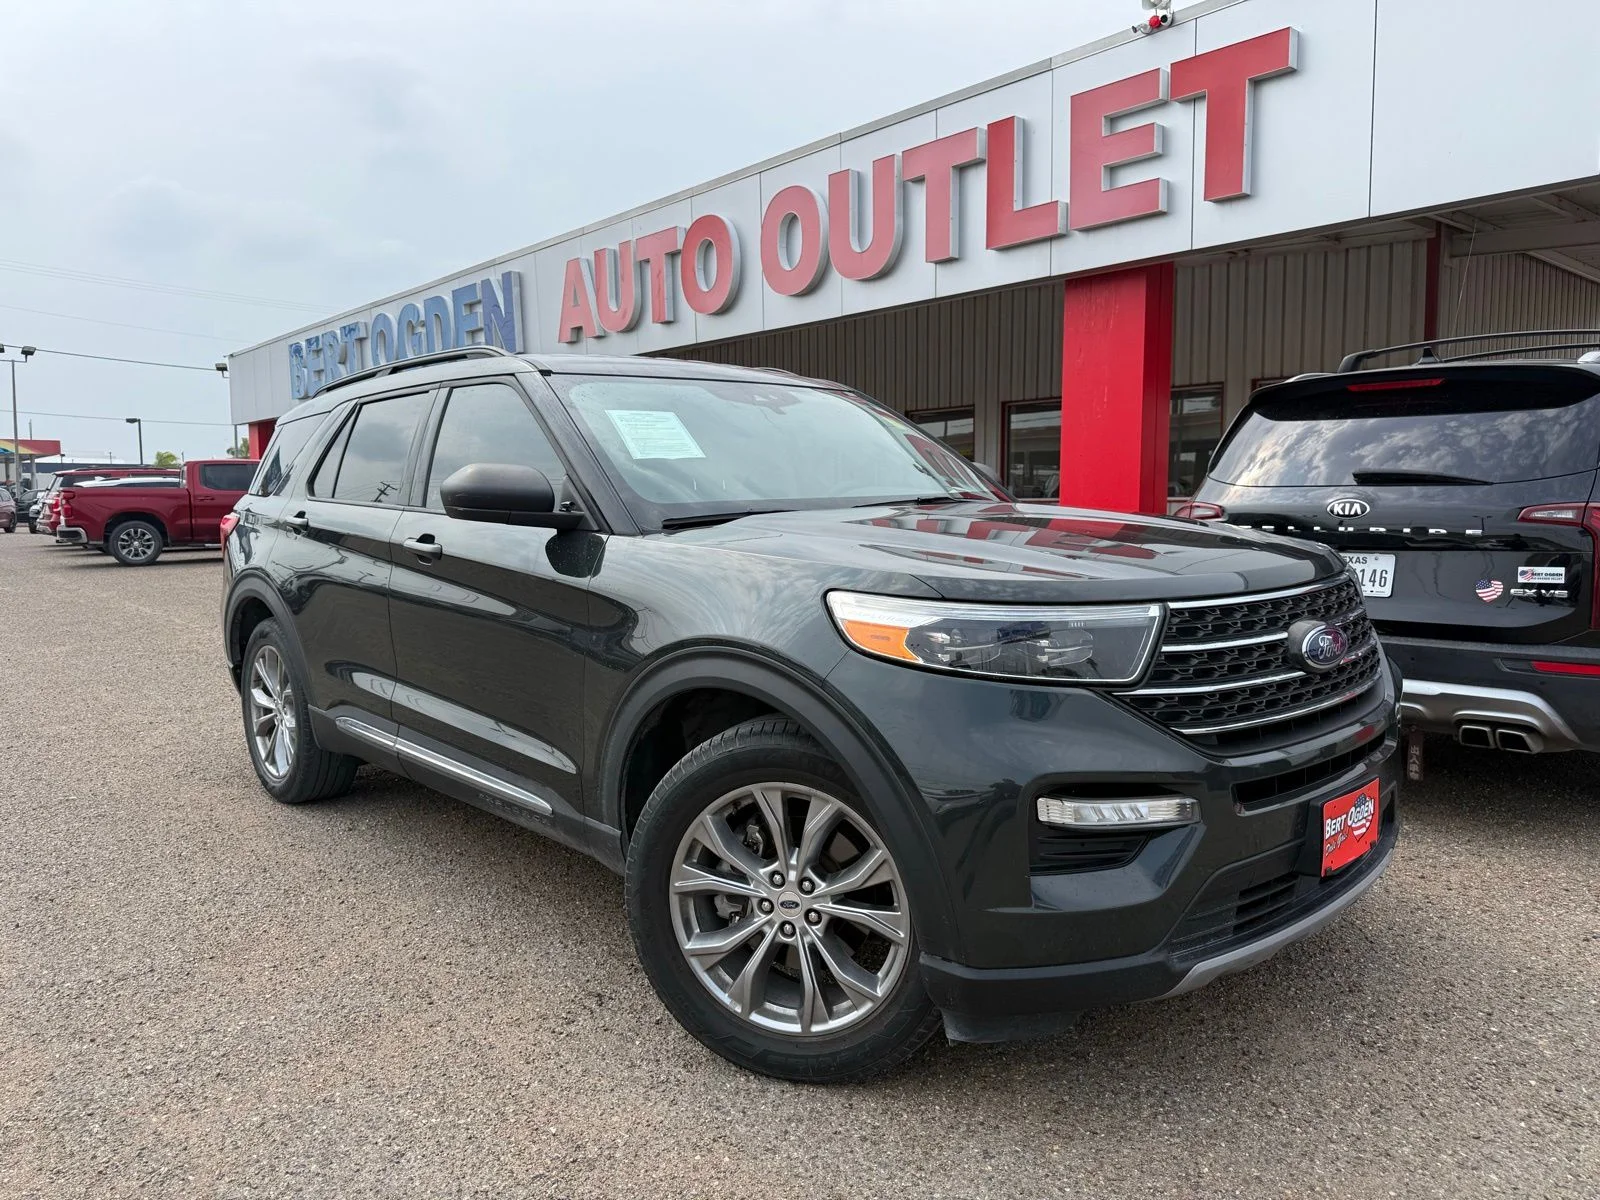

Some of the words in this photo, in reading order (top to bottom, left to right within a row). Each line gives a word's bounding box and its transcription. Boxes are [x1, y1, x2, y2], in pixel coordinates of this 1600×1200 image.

[289, 321, 366, 400] BERT
[371, 271, 523, 367] OGDEN
[558, 214, 741, 343] AUTO
[760, 27, 1298, 296] OUTLET
[1334, 503, 1362, 515] KIA
[1341, 556, 1368, 565] EXAS
[1356, 568, 1388, 588] 146
[1510, 588, 1537, 597] EX
[1318, 634, 1342, 660] Ford
[1325, 813, 1347, 840] BERT
[1347, 799, 1375, 827] OGDEN
